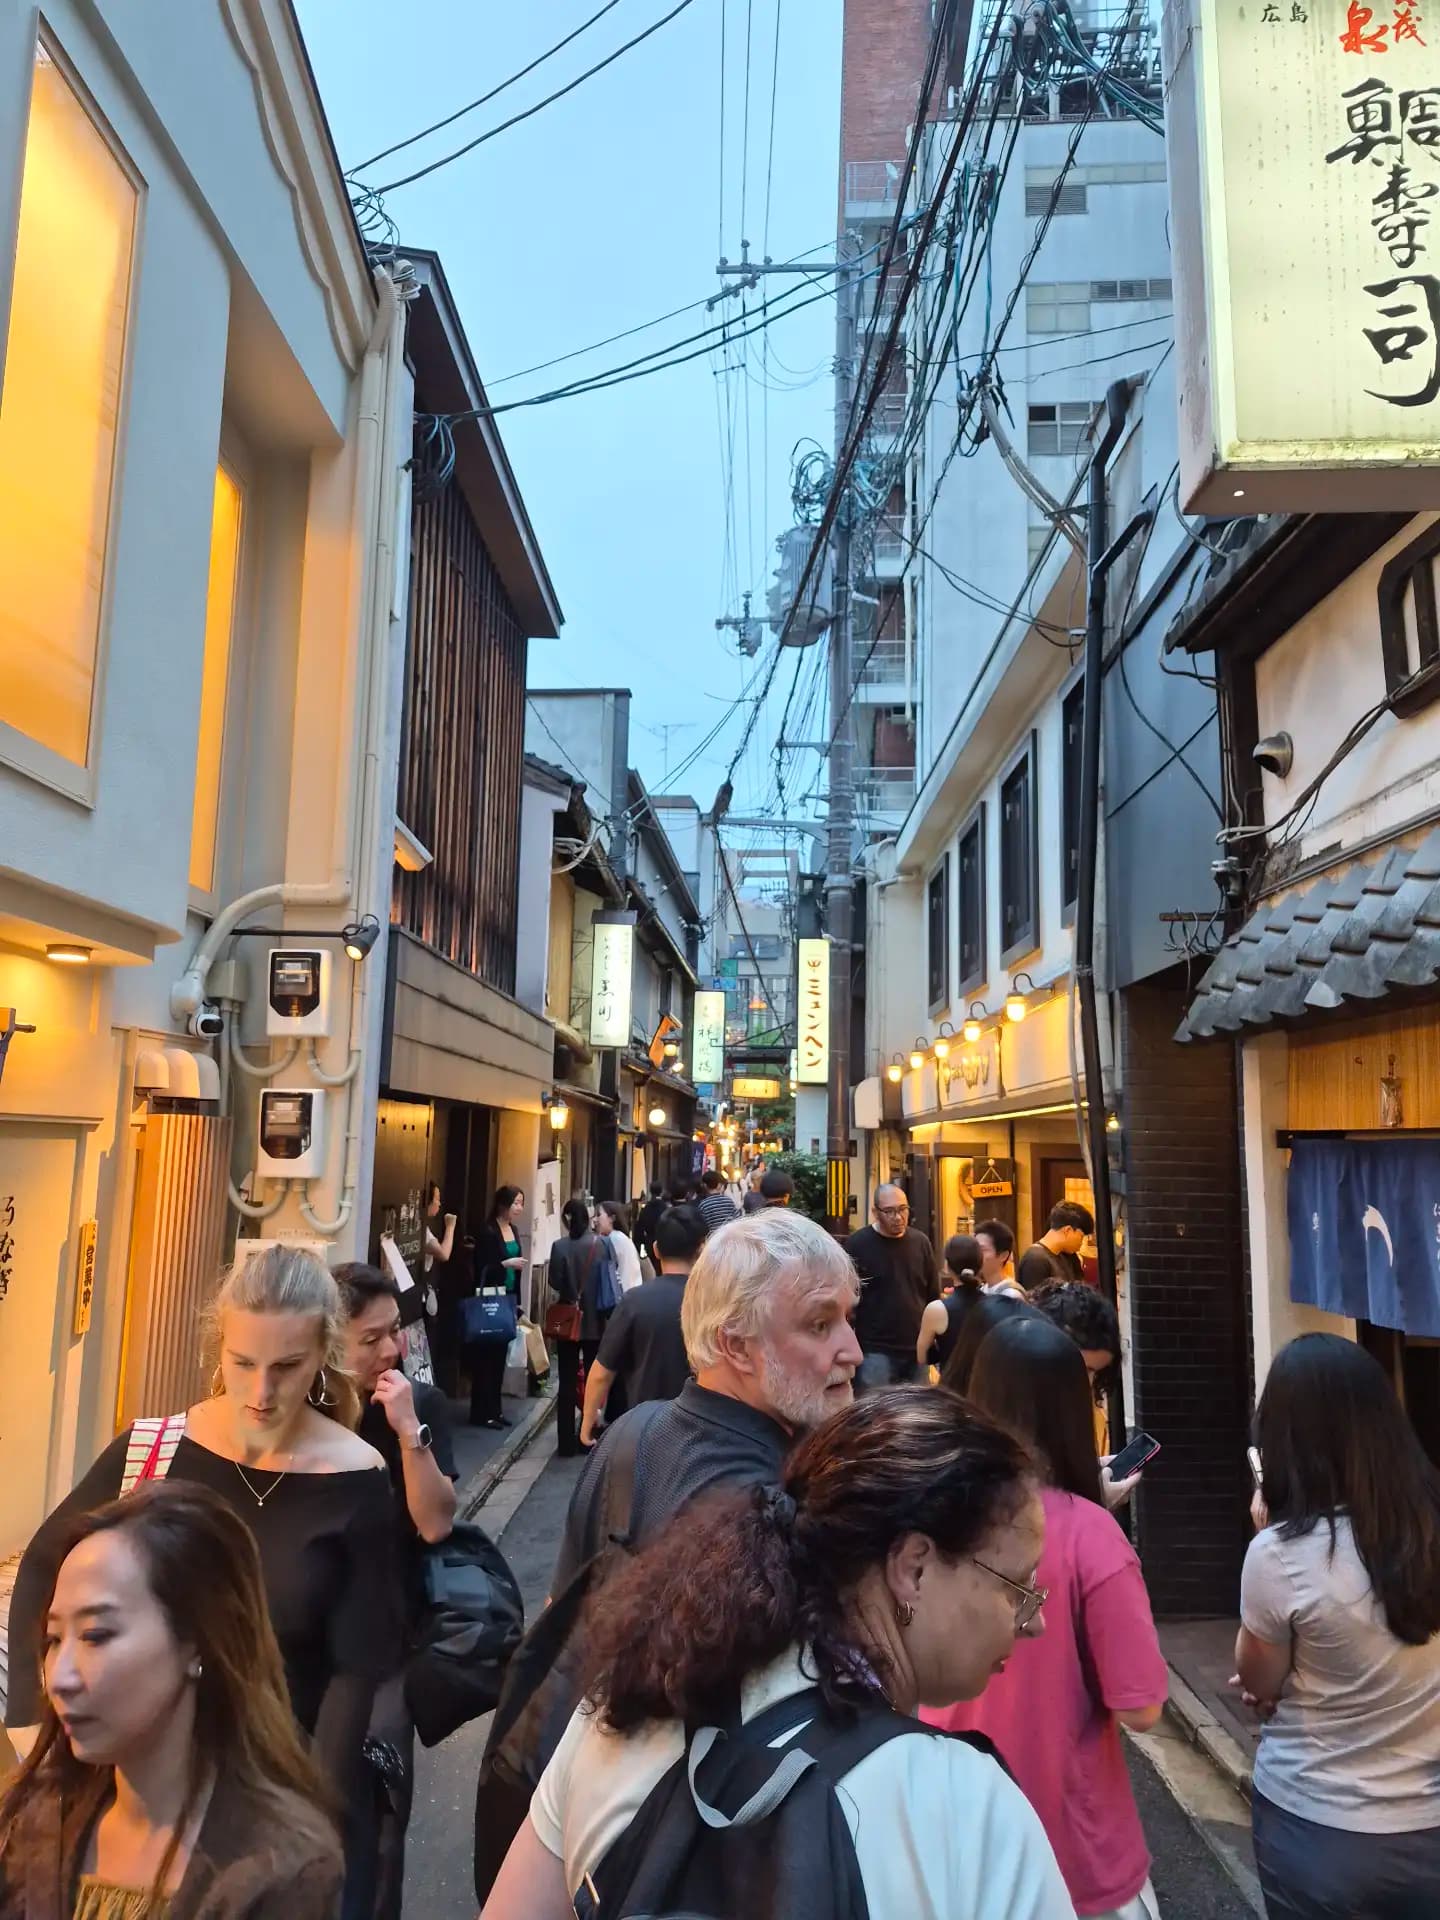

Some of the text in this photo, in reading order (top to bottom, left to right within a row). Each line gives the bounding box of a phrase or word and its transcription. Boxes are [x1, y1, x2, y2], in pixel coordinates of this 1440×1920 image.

[1260, 1, 1309, 23] 広島
[804, 977, 824, 1067] ミュンヘン
[980, 1185, 1003, 1194] OPEN
